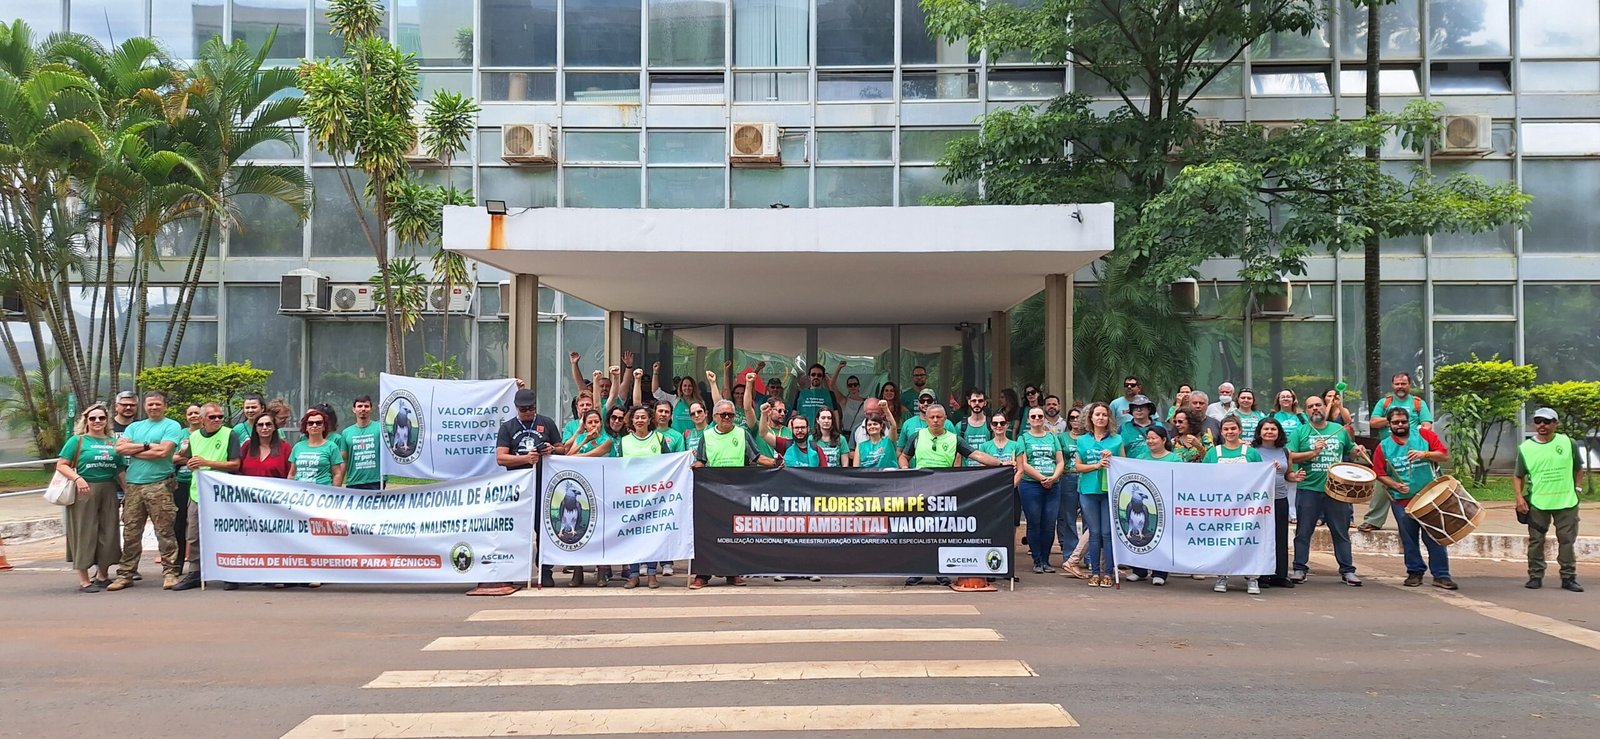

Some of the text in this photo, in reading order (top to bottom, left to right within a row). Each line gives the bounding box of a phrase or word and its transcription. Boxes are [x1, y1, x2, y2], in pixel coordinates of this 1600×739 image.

[437, 405, 510, 416] VALORIZAR O
[441, 420, 495, 429] SERVIDOR
[445, 446, 495, 456] NATUREZ
[624, 480, 674, 495] REVISÃO
[213, 481, 521, 510] PARAMETRIZAÇÃO COM A AGÊNCIA NACIONAL DE ÁGUAS
[612, 492, 683, 509] IMEDIATA DA
[1177, 491, 1269, 503] NA LUTA PARA
[750, 493, 958, 513] NÃO TEM FLORESTA EM PÉ SEM
[621, 508, 675, 523] CARREIRA
[1175, 505, 1272, 517] REESTRUTURAR
[213, 515, 258, 536] PROPORÇÃO
[258, 518, 295, 534] SALARIAL
[298, 519, 309, 533] DE
[350, 523, 374, 536] ENTRE
[419, 519, 461, 533] ANALISTAS
[461, 518, 468, 532] E
[467, 517, 515, 533] AUXILIARES
[617, 522, 679, 537] AMBIENTAL
[735, 516, 977, 533] SERVIDOR AMBIENTAL VALORIZADO
[1185, 521, 1261, 532] A CARREIRA
[798, 537, 851, 545] REESTRUTURAÇÃO
[1187, 536, 1259, 547] AMBIENTAL
[218, 555, 440, 568] EXIGÊNCIA DE NÍVEL SUPERIOR PARA TÉCNICOS.
